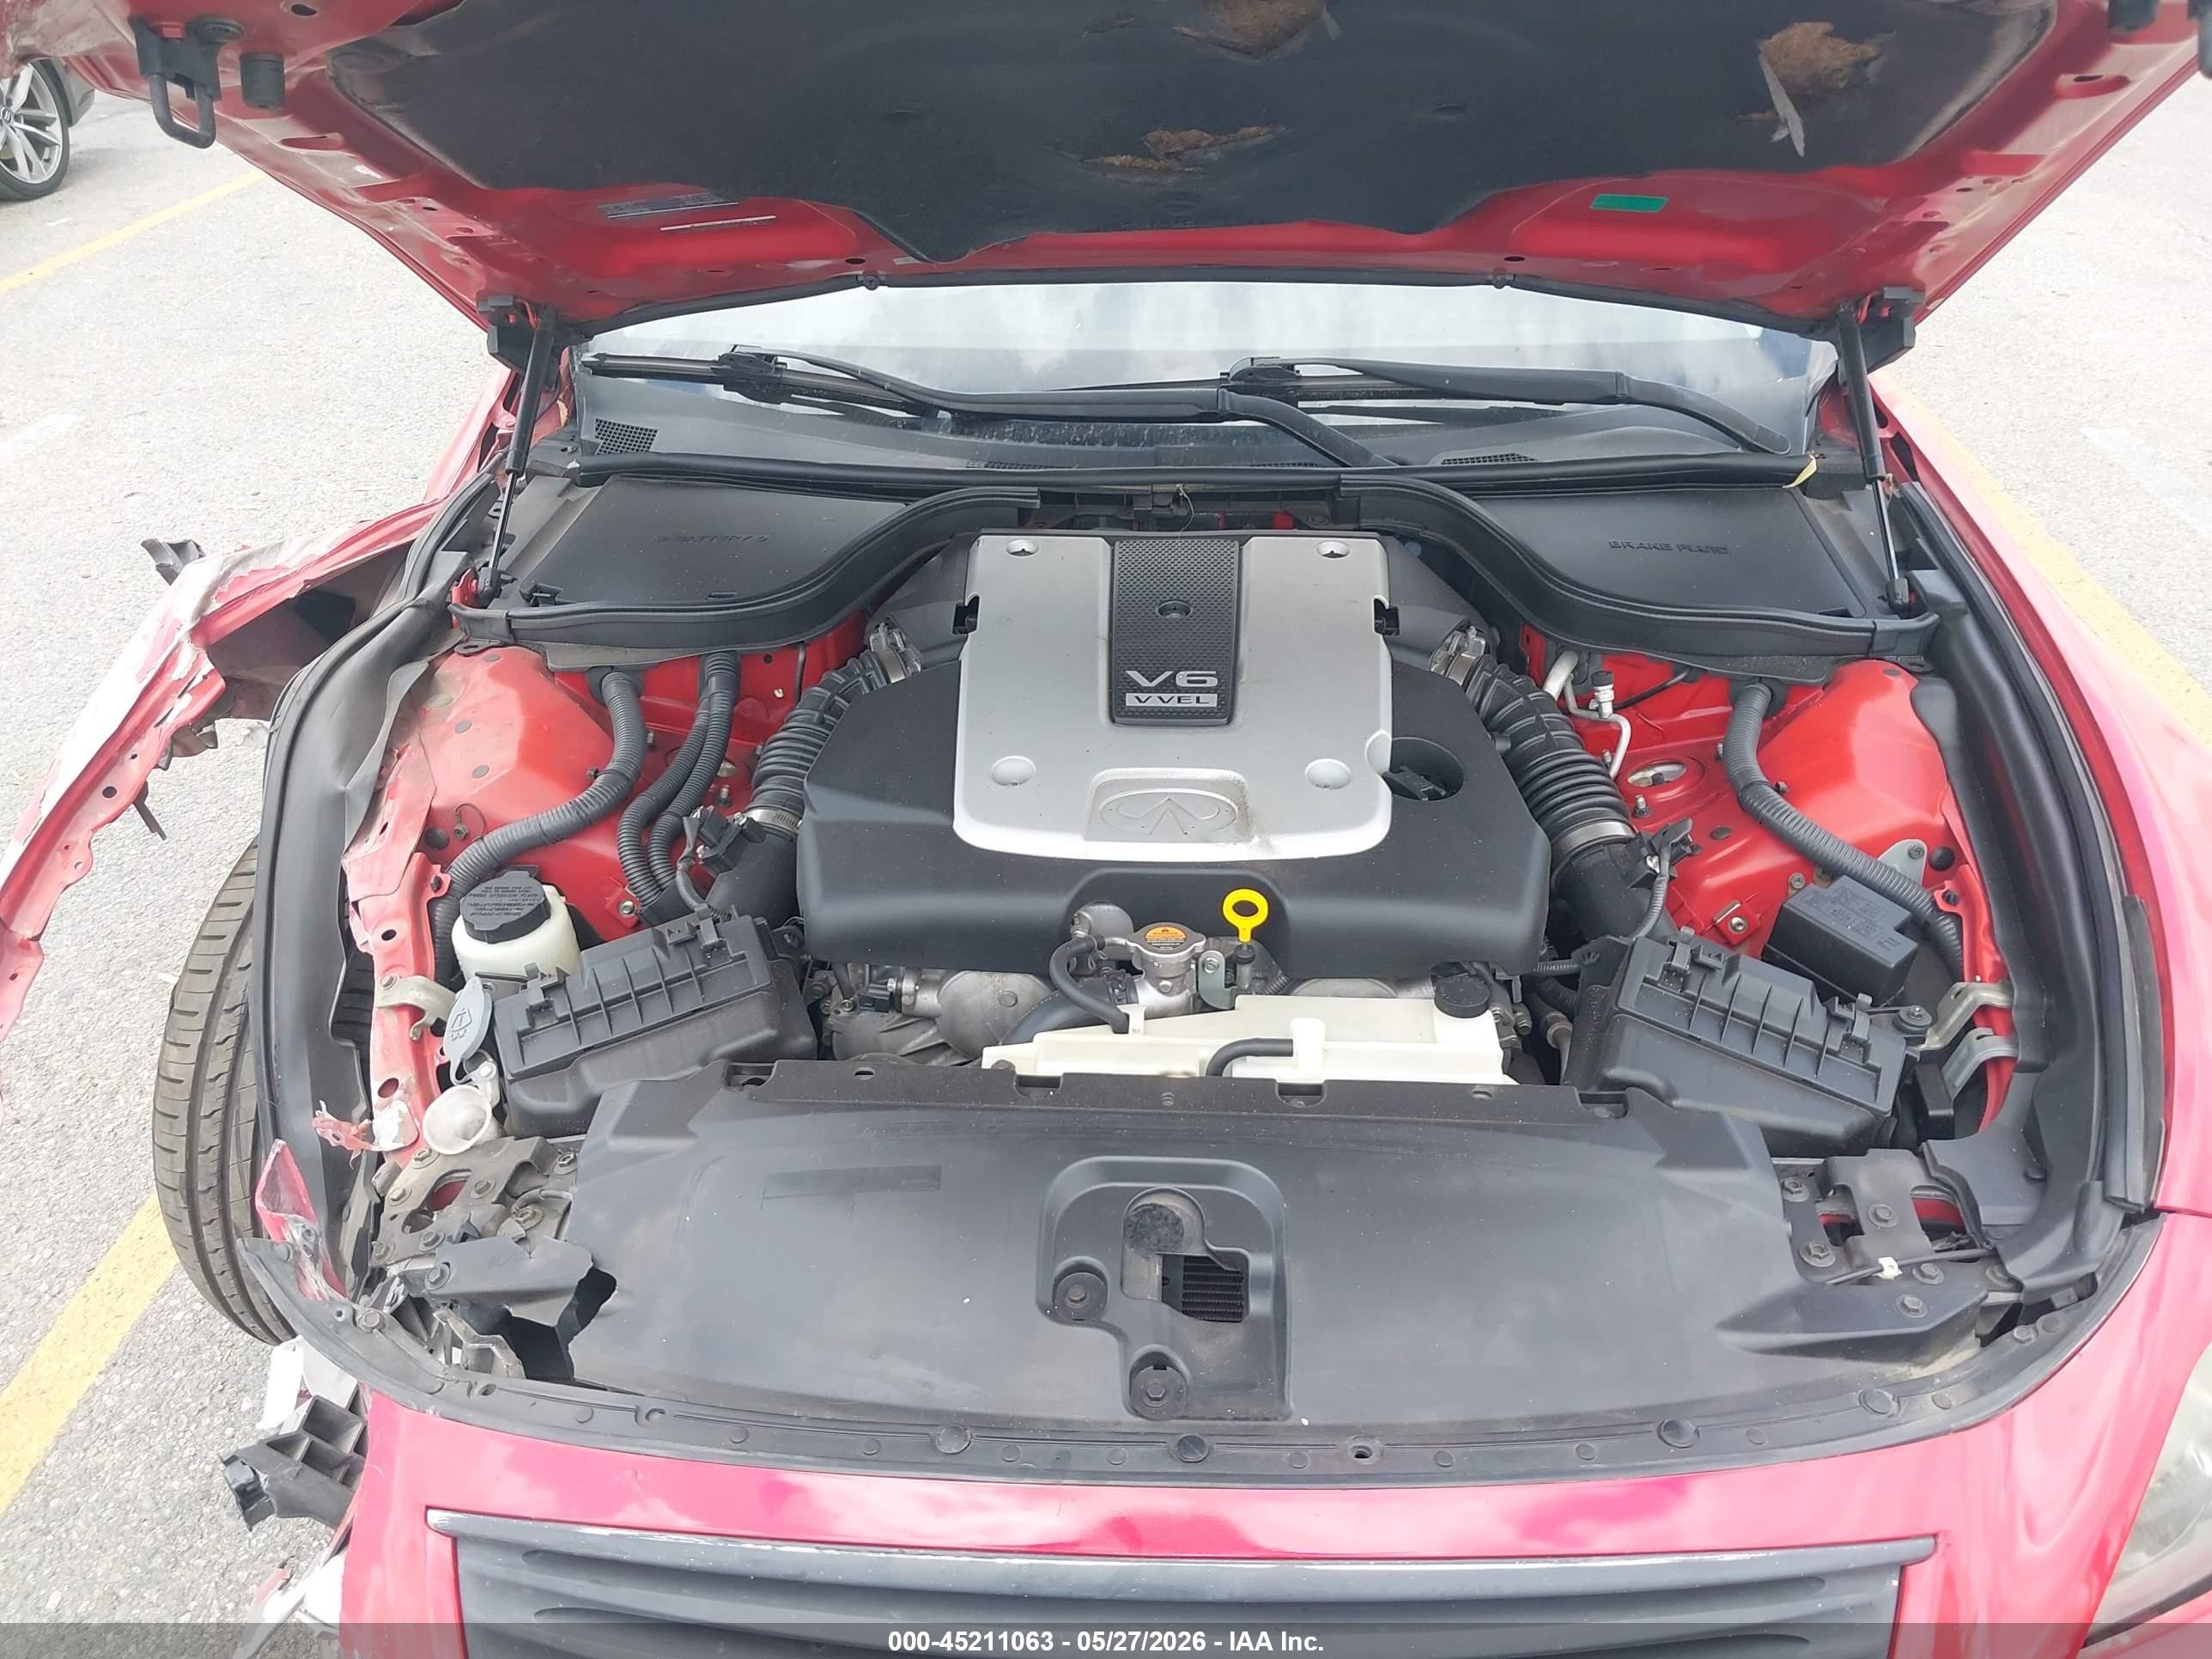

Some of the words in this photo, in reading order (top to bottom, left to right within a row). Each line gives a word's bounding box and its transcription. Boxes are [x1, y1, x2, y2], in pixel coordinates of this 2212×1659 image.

[1607, 540, 1673, 551] BRAKE
[1125, 670, 1218, 688] V6
[1133, 695, 1210, 705] VVEL
